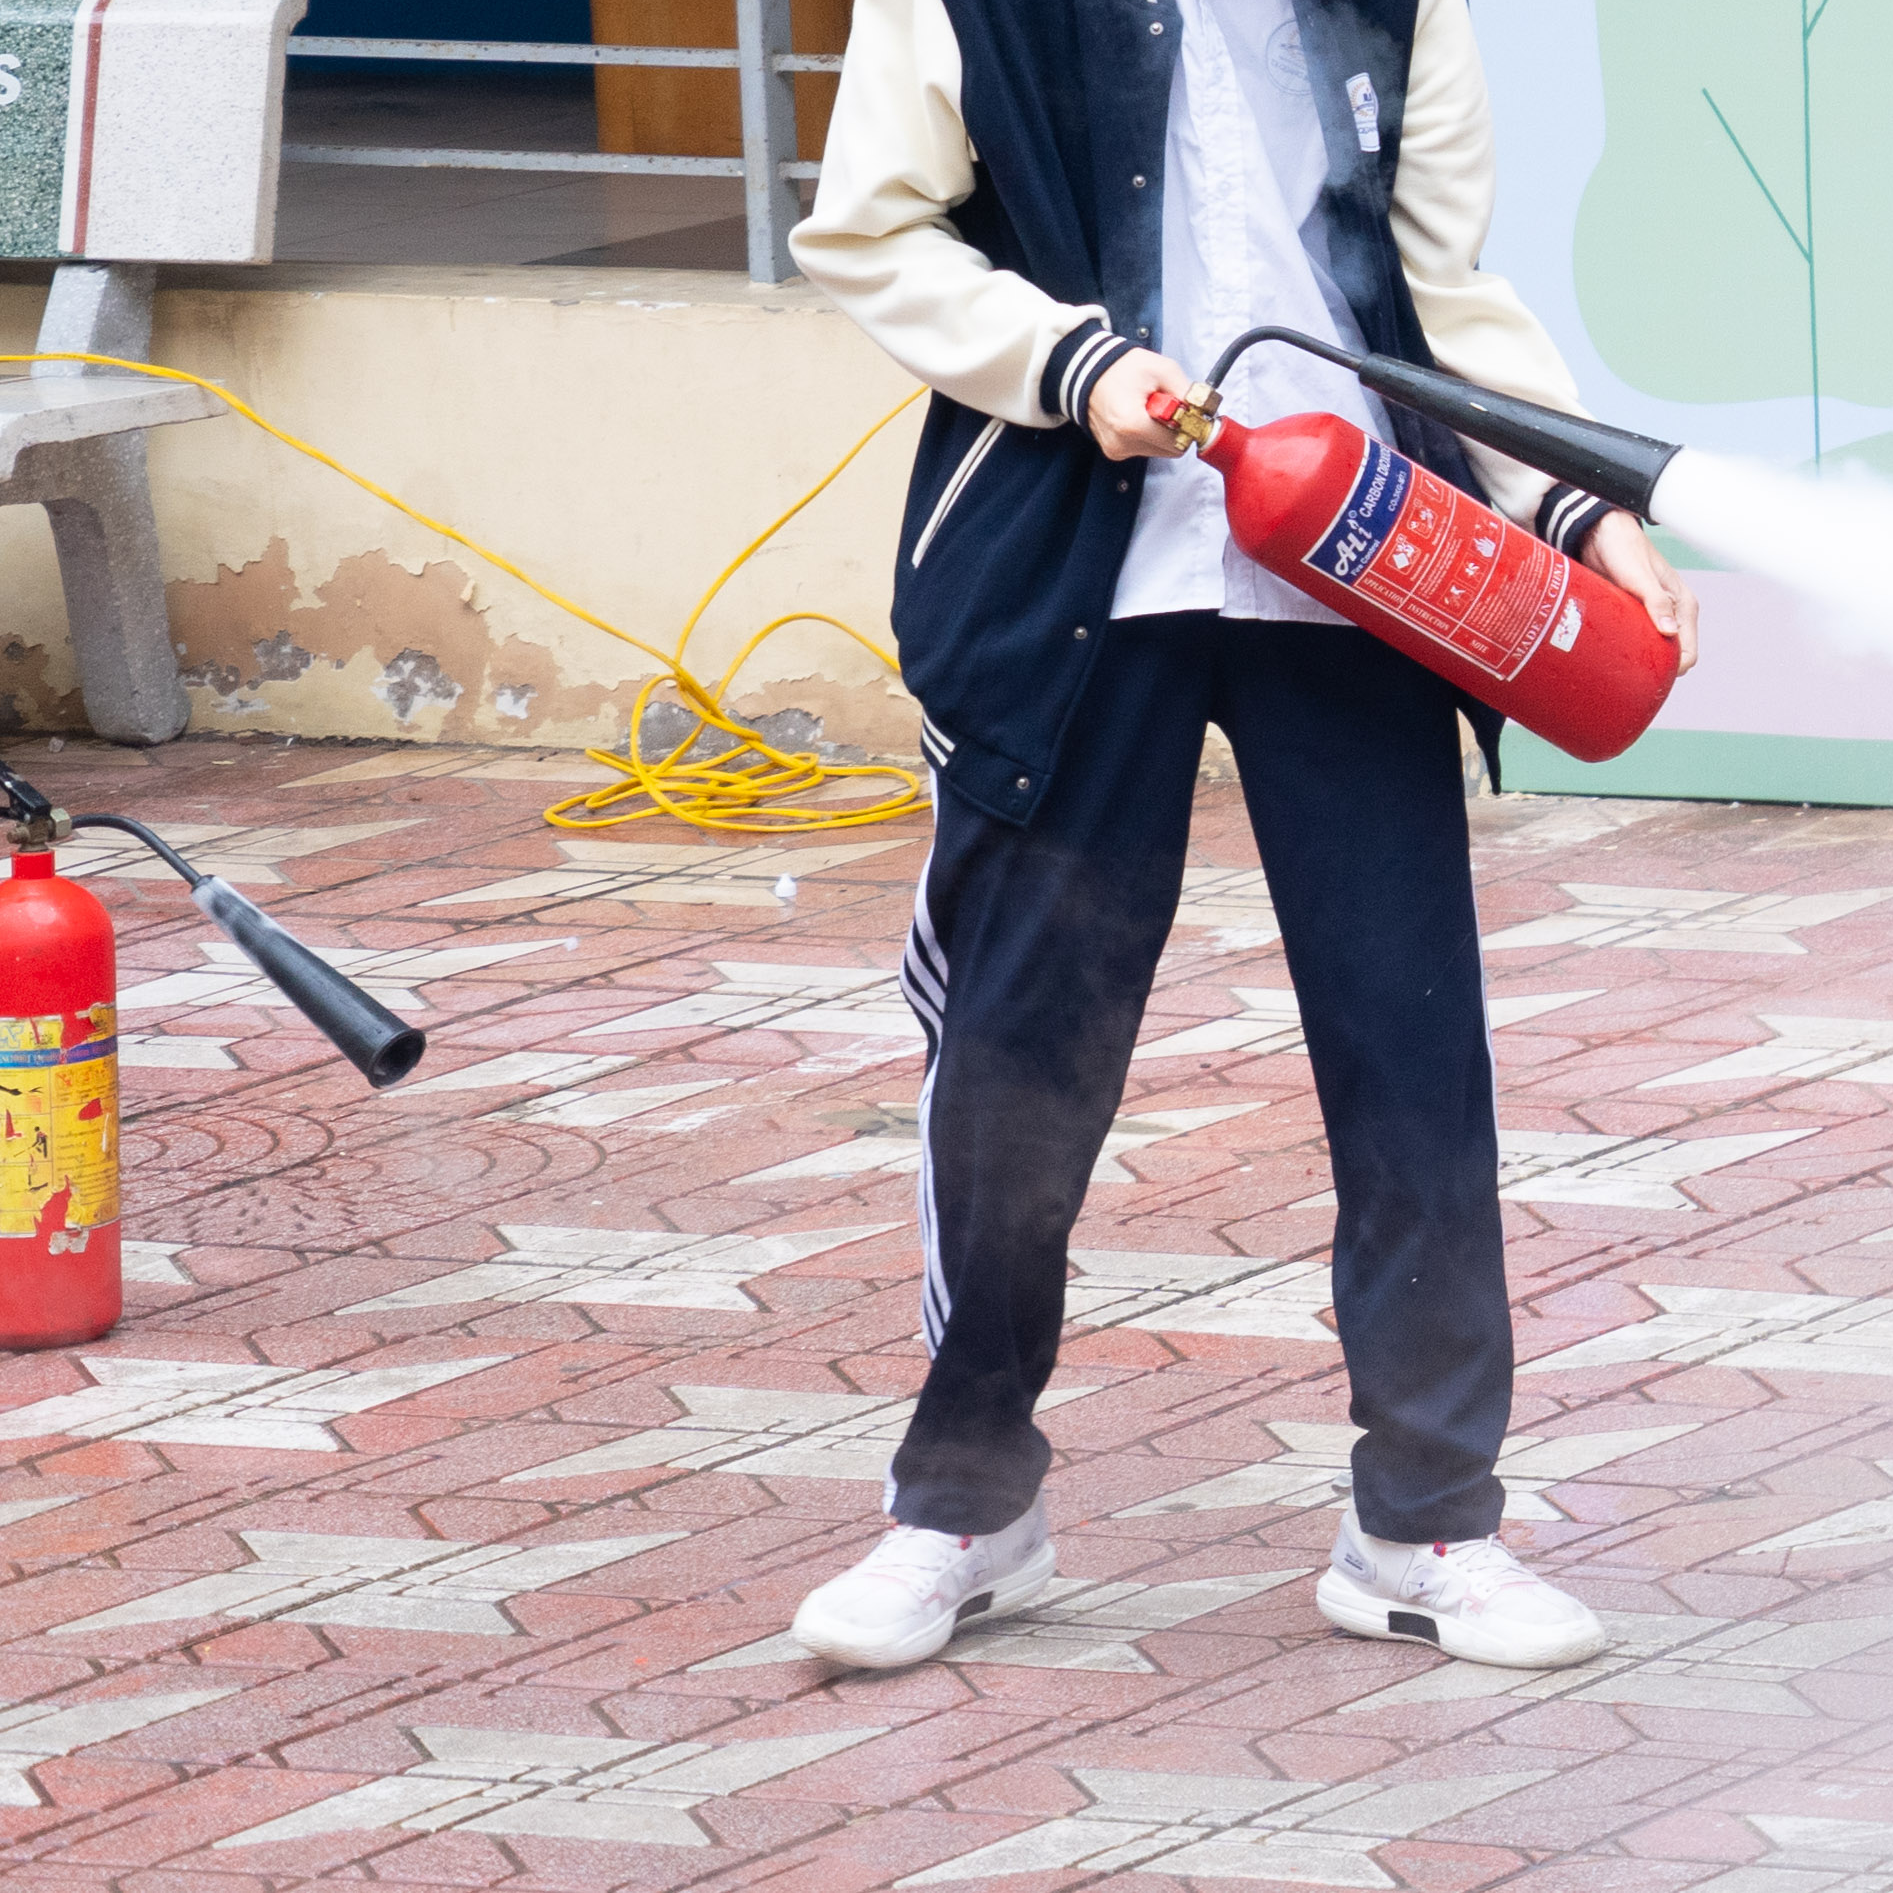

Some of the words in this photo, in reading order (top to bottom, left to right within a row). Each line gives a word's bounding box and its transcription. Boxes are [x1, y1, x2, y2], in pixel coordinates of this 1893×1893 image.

[1359, 473, 1387, 518] CARBON
[1514, 619, 1543, 660] MADE
[1538, 602, 1552, 619] IN
[1549, 563, 1565, 599] CHINA
